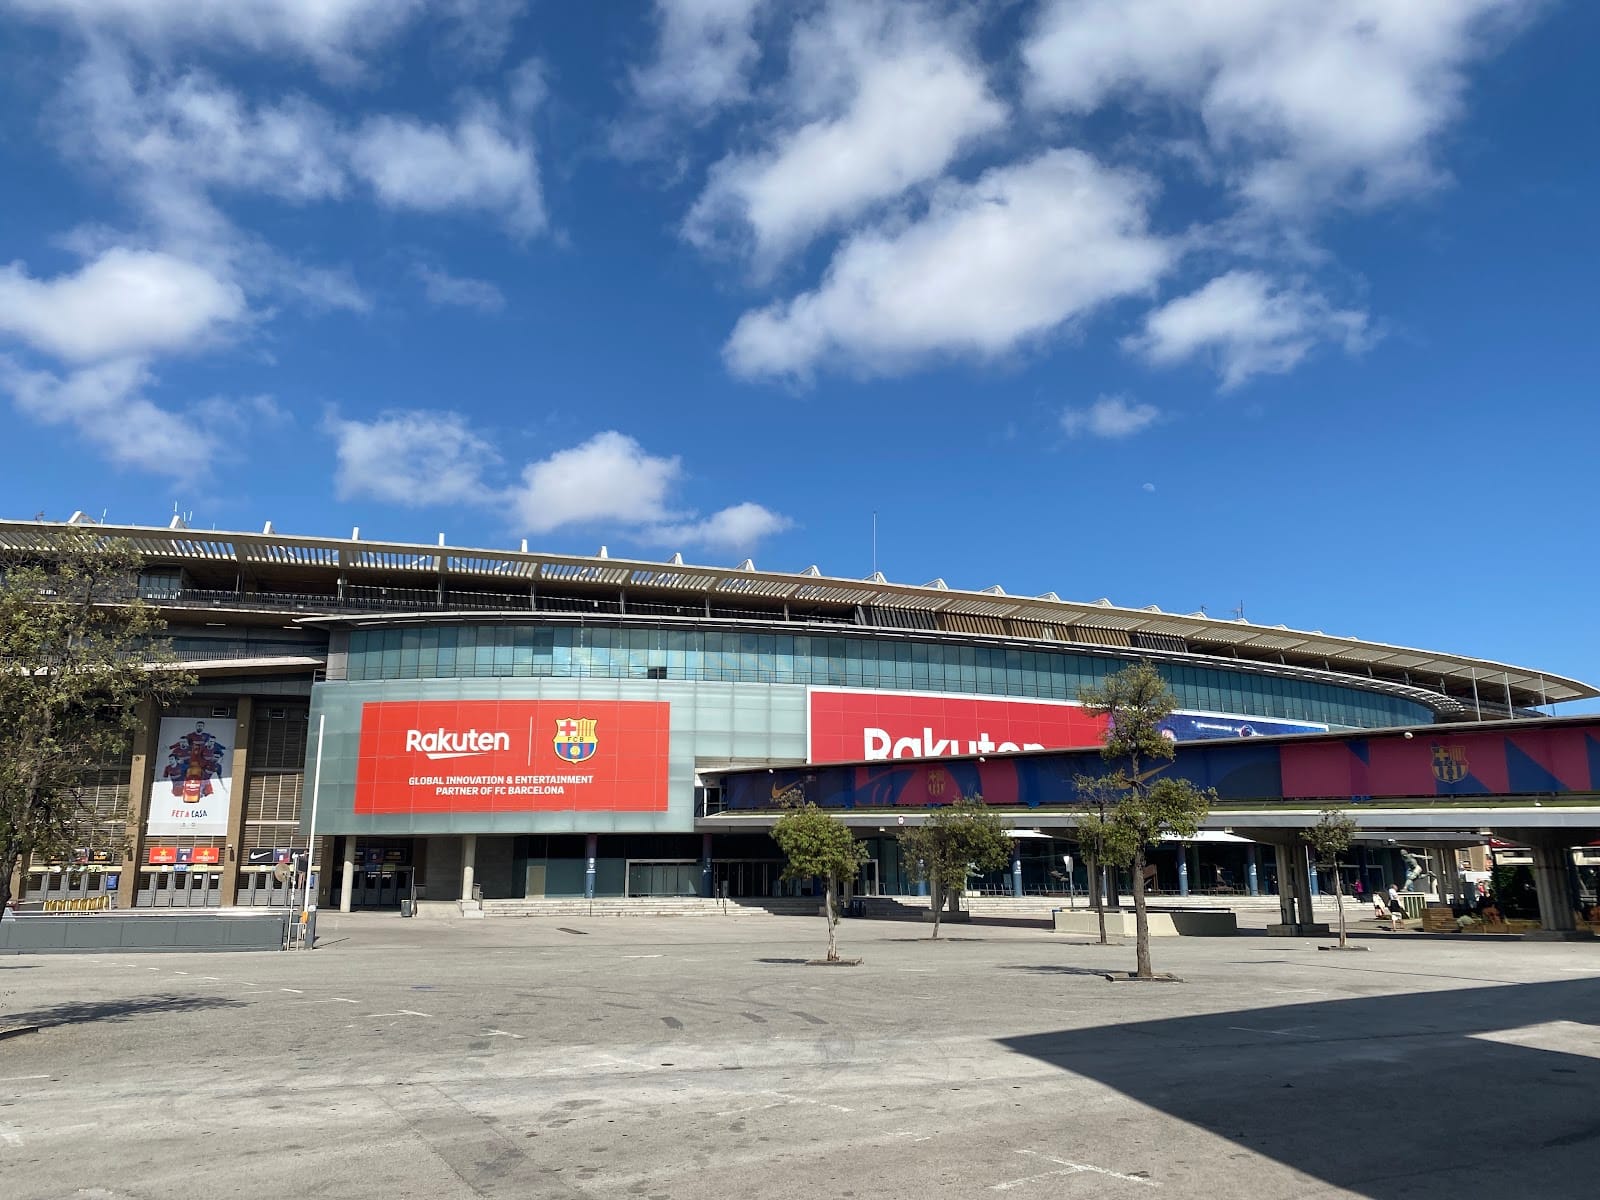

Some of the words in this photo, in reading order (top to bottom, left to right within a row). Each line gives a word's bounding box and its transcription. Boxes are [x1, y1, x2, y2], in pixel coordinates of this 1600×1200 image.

[406, 728, 510, 752] Rakuten
[408, 777, 444, 786] GLOBAL
[446, 776, 503, 785] INNOVATION
[506, 776, 513, 784] &
[515, 775, 594, 784] ENTERTAINMENT
[436, 786, 478, 795] PARTNER
[480, 786, 493, 795] OF
[494, 786, 507, 795] FC
[508, 785, 564, 795] BARCELONA
[171, 810, 184, 818] FET
[191, 810, 208, 818] CASA
